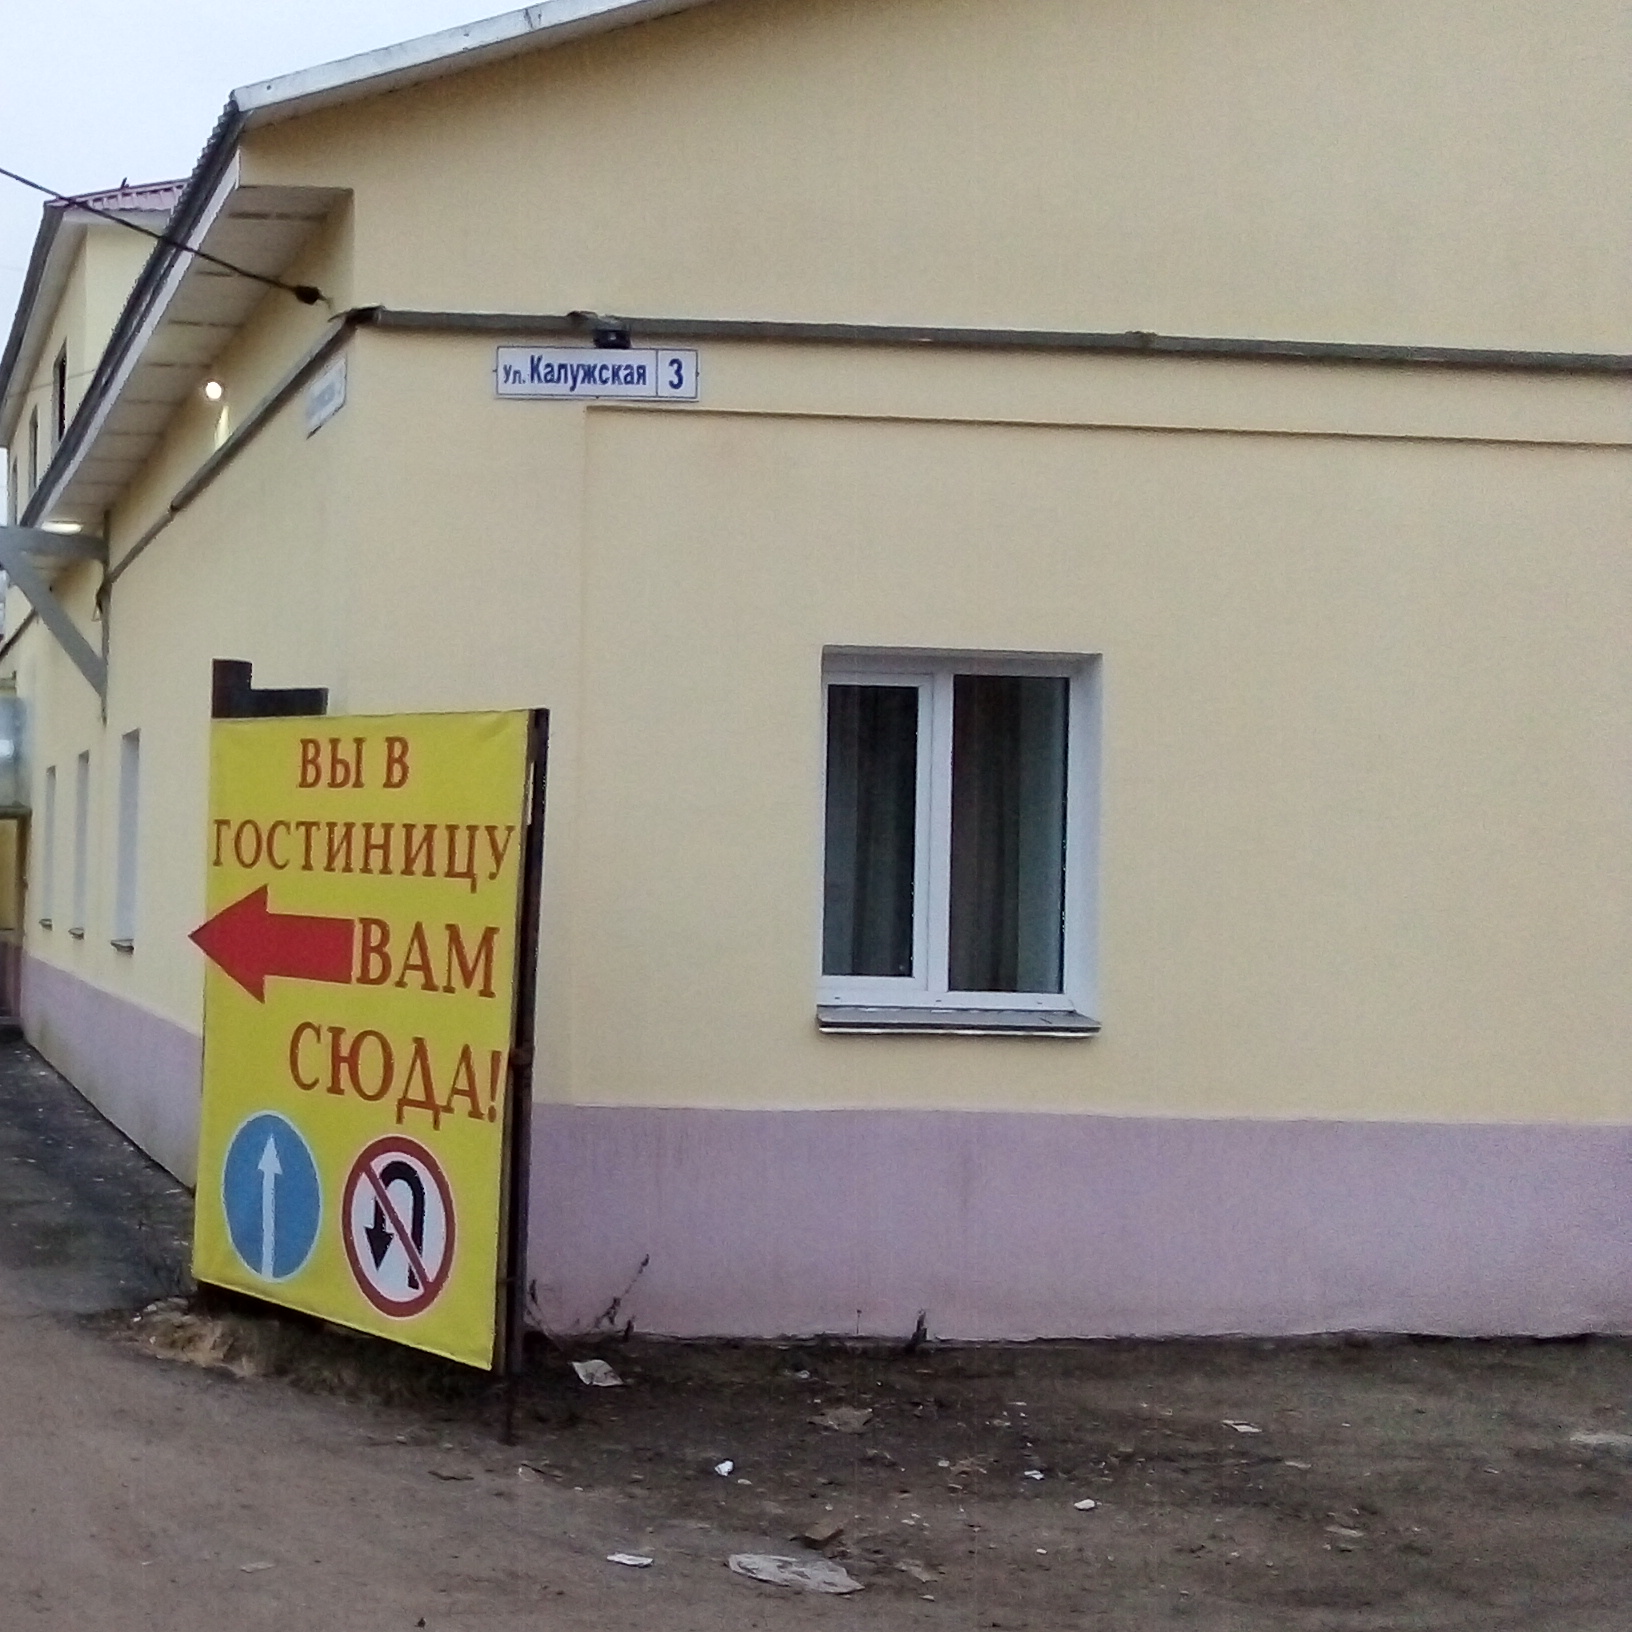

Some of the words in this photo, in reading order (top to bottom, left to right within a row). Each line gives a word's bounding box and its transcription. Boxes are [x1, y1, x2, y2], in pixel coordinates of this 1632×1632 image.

[530, 354, 647, 392] Калужская
[668, 357, 684, 390] 3
[298, 737, 366, 789] ВЫ
[382, 735, 410, 789] В
[212, 818, 516, 894] ГОСТИНИЦУ
[355, 916, 501, 999] ВАМ
[288, 1020, 503, 1131] СЮДА!
